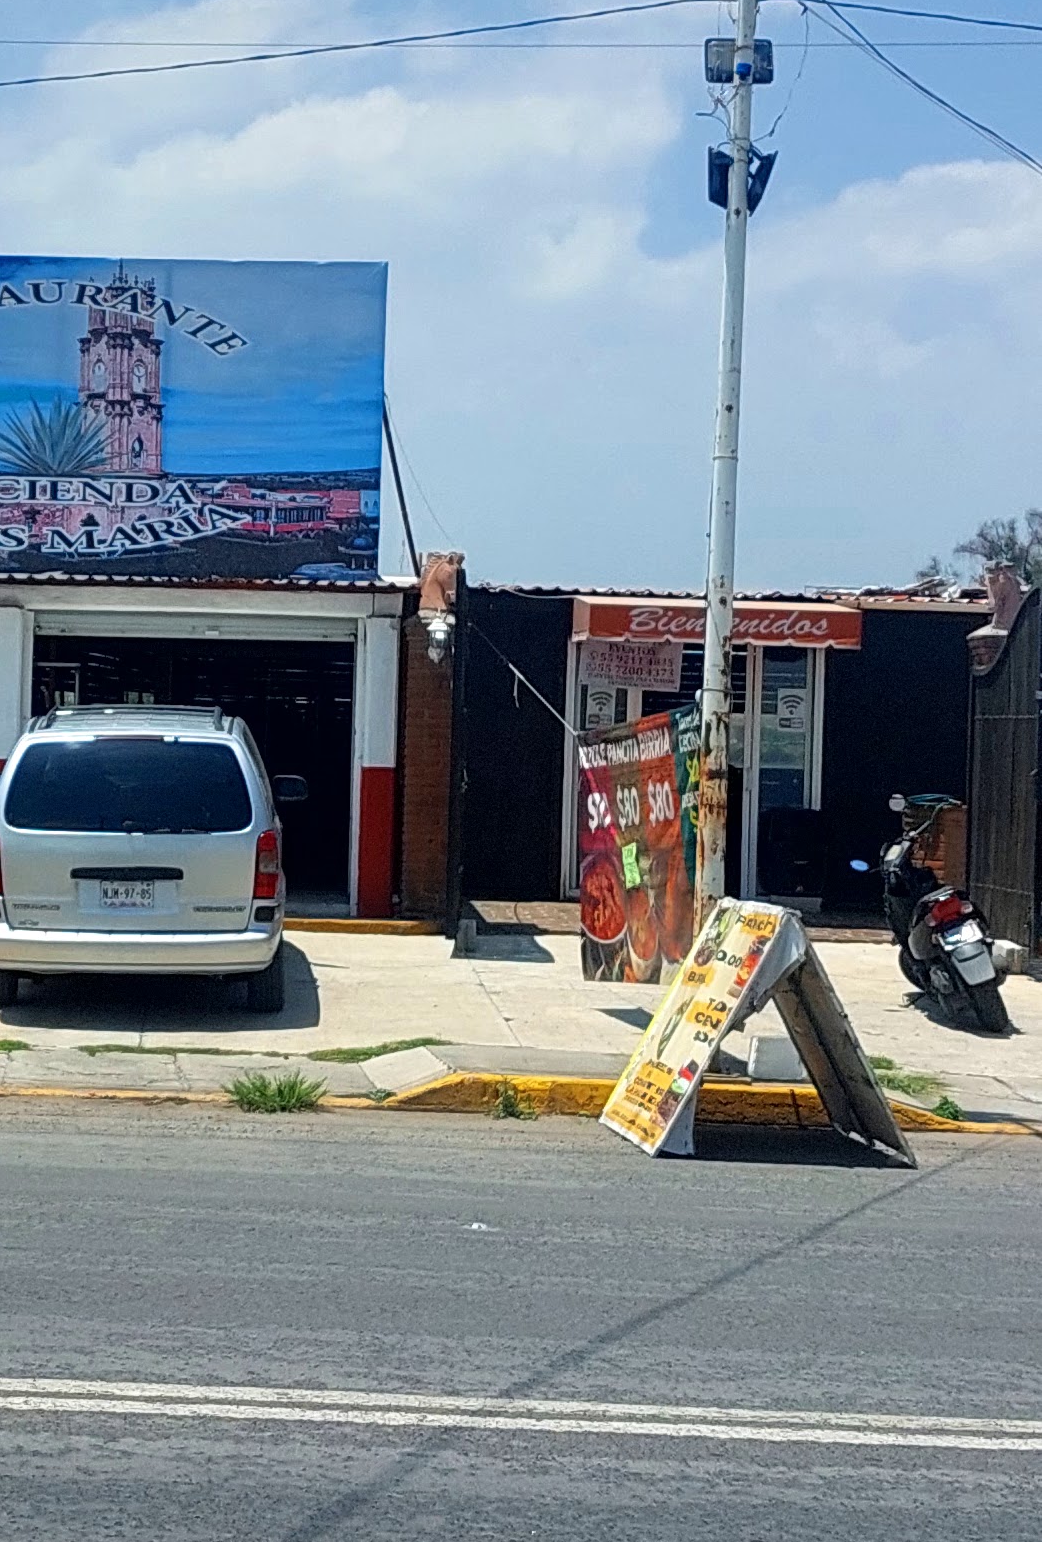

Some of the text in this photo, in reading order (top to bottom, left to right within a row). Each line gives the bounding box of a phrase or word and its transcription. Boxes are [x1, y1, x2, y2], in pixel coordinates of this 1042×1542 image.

[41, 503, 251, 554] MARÍA
[629, 608, 829, 635] Bienenidos
[637, 727, 672, 762] BIRRIA
[616, 784, 640, 832] $80
[647, 779, 676, 828] $80
